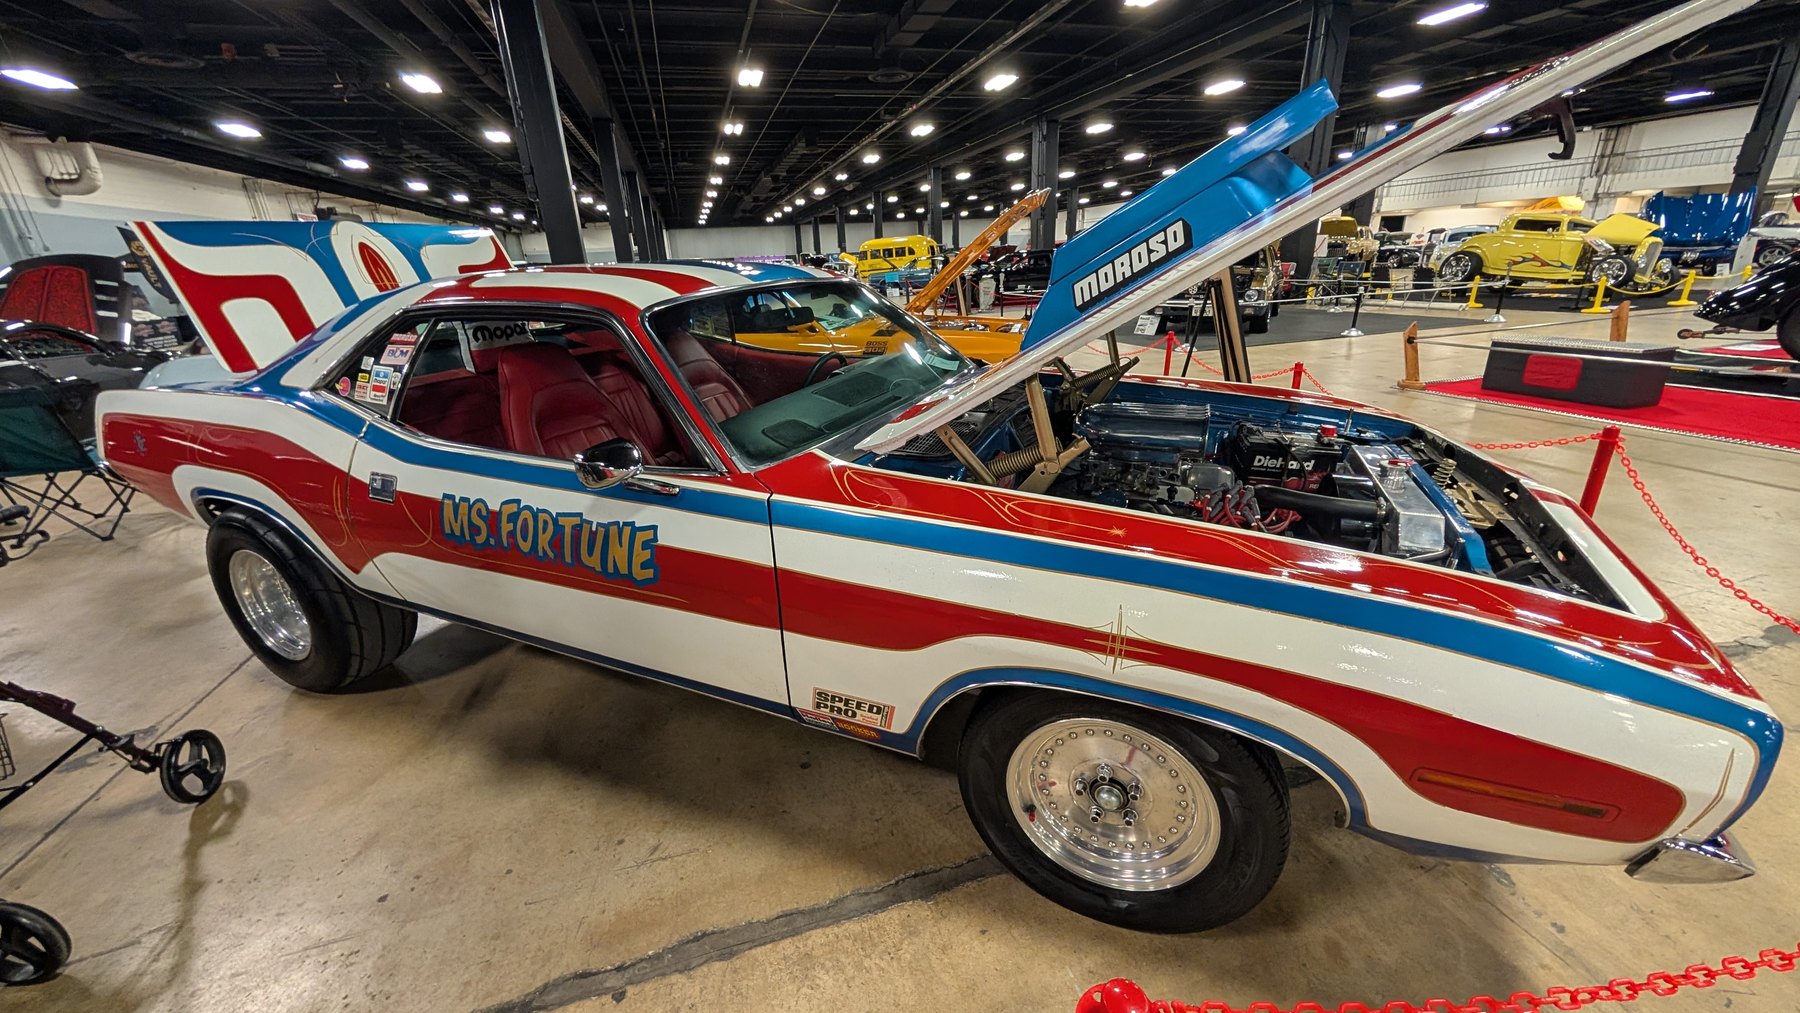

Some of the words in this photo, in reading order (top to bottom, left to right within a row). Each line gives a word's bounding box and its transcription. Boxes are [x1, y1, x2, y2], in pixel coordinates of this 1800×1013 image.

[1074, 219, 1185, 307] MOROSO
[472, 322, 528, 343] Mopar
[442, 493, 496, 548] MS.
[500, 498, 659, 588] FORTUNE
[815, 701, 858, 719] PRO
[816, 691, 883, 715] SPEED
